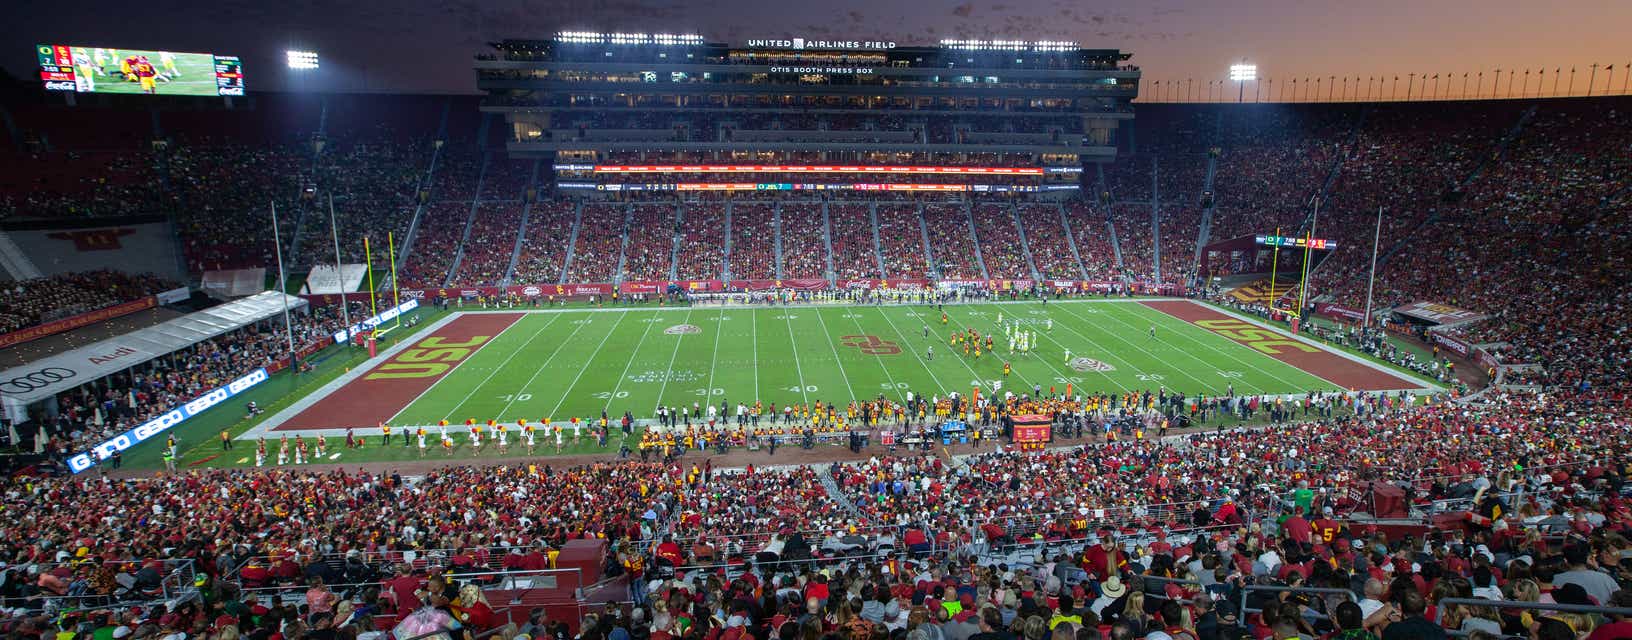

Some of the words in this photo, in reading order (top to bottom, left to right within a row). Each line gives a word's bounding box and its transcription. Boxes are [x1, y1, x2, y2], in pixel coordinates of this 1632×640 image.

[748, 39, 791, 47] UNITED
[806, 40, 859, 48] AIRLINES
[865, 41, 896, 49] FIELD
[1193, 319, 1323, 355] USC
[88, 346, 137, 365] Audi
[364, 336, 491, 380] USC
[229, 369, 266, 394] GEICO
[695, 388, 725, 396] 30
[185, 387, 227, 415] GEICO
[600, 391, 630, 399] 20
[134, 409, 183, 440] GEICO
[1323, 528, 1334, 542] 5
